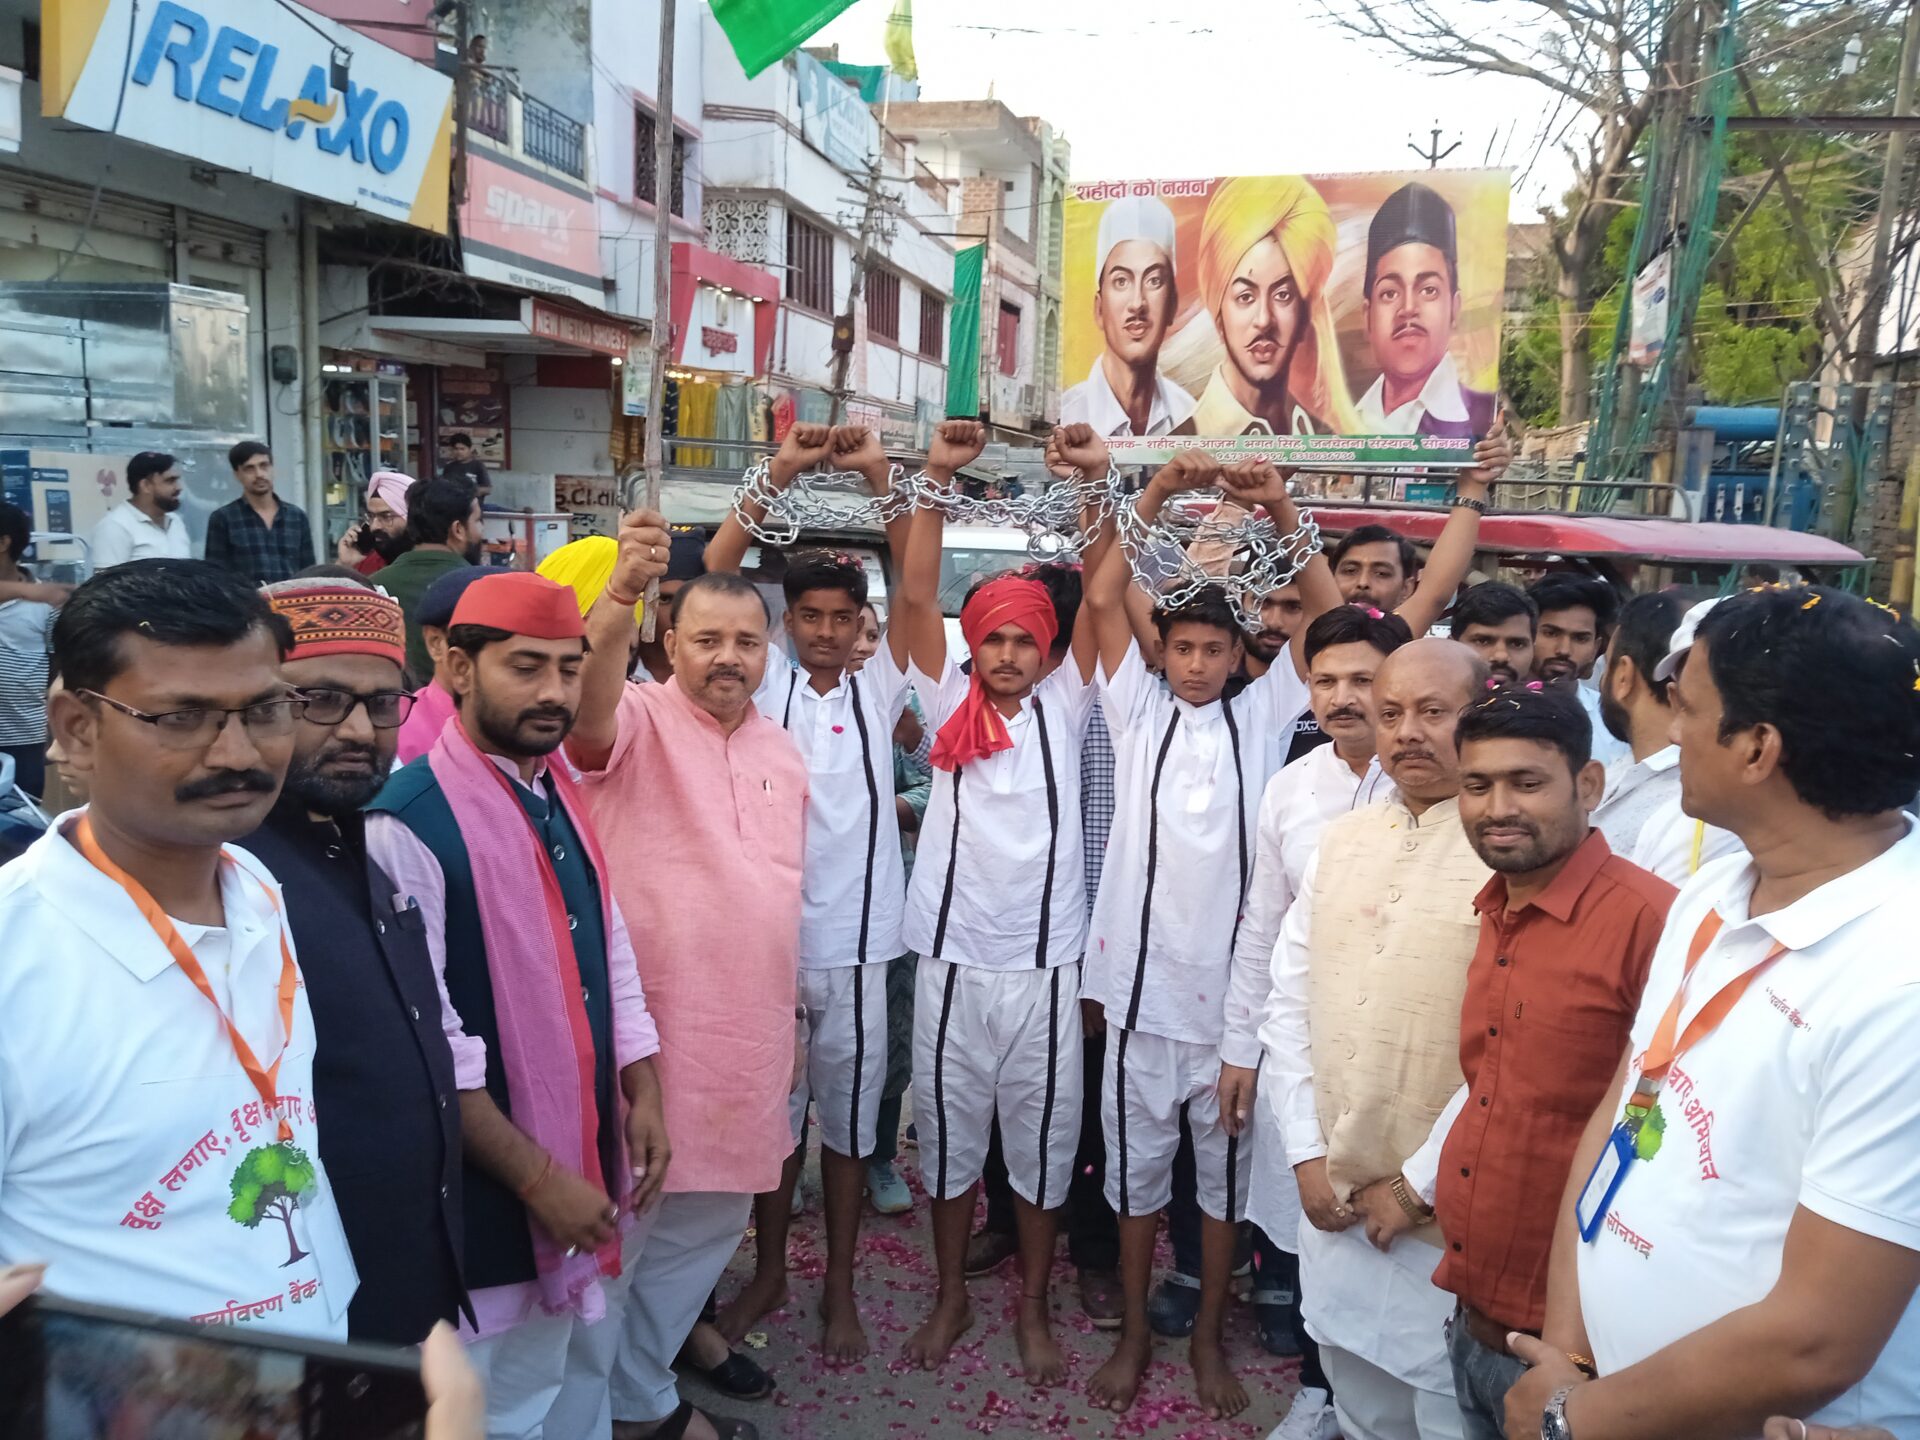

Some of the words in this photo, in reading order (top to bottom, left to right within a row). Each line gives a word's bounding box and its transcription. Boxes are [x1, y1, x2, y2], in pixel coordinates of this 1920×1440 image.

[132, 0, 410, 175] RELAXO
[1132, 178, 1157, 197] को
[485, 185, 576, 242] sparx
[509, 272, 523, 284] NEW
[525, 277, 546, 291] METRO
[536, 308, 558, 336] NEW
[560, 315, 592, 344] METRO
[592, 323, 621, 351] SHOES
[1243, 438, 1273, 449] भगत
[119, 1191, 166, 1230] वृक्ष
[230, 1099, 263, 1143] वृक्ष
[1684, 1098, 1720, 1181] अभियान
